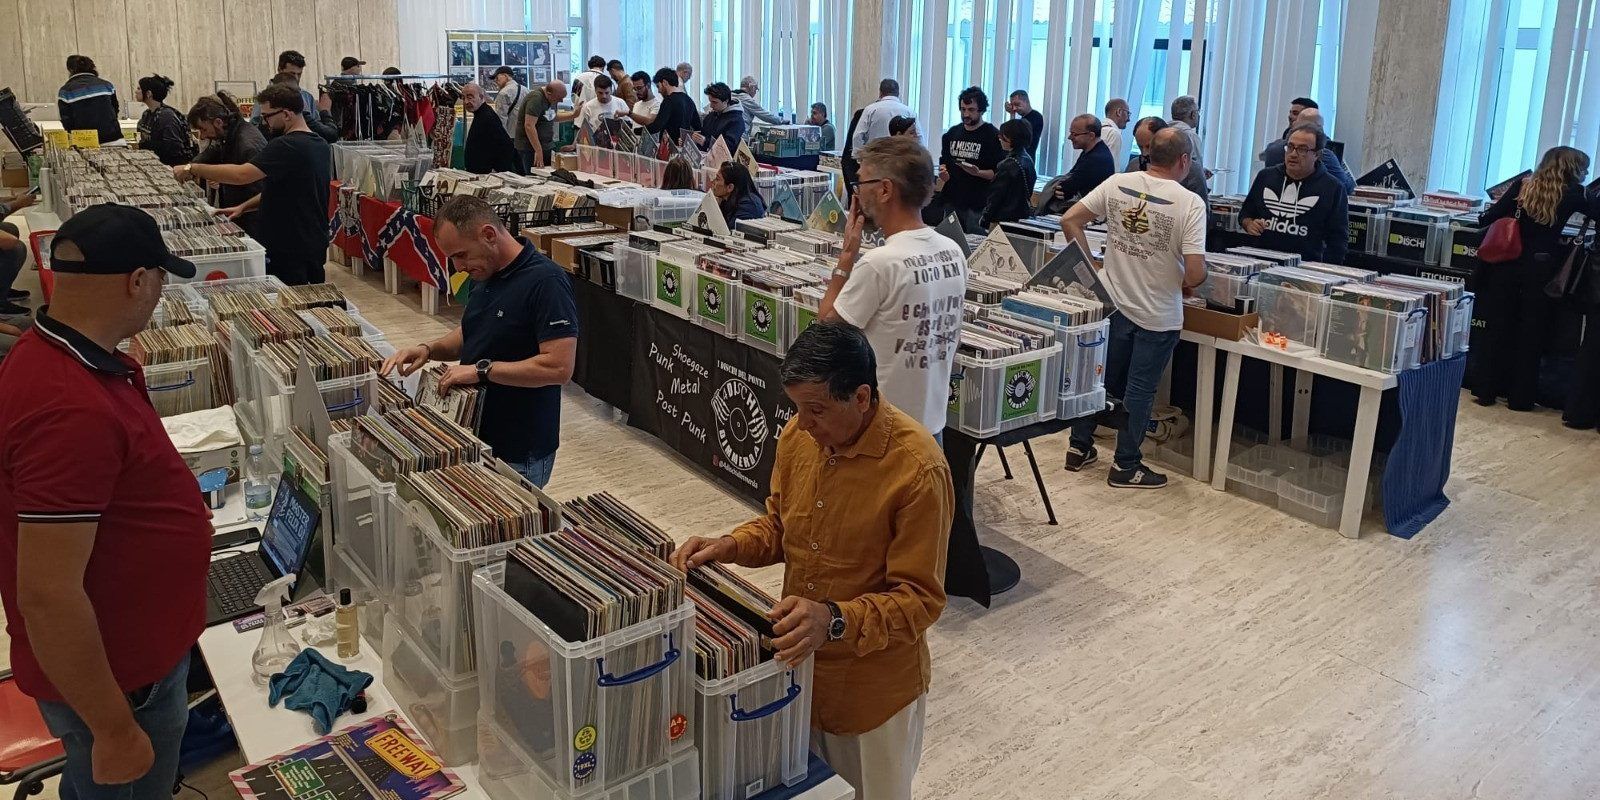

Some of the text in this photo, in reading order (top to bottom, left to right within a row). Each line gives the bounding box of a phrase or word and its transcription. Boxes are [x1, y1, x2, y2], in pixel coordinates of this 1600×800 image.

[942, 262, 961, 279] KM
[1421, 271, 1466, 285] ETICHETTA
[649, 342, 674, 373] Punk
[672, 344, 709, 379] Shoegaze
[671, 377, 700, 394] Metal
[656, 390, 706, 444] Post Punk
[375, 734, 434, 775] FREEWAY
